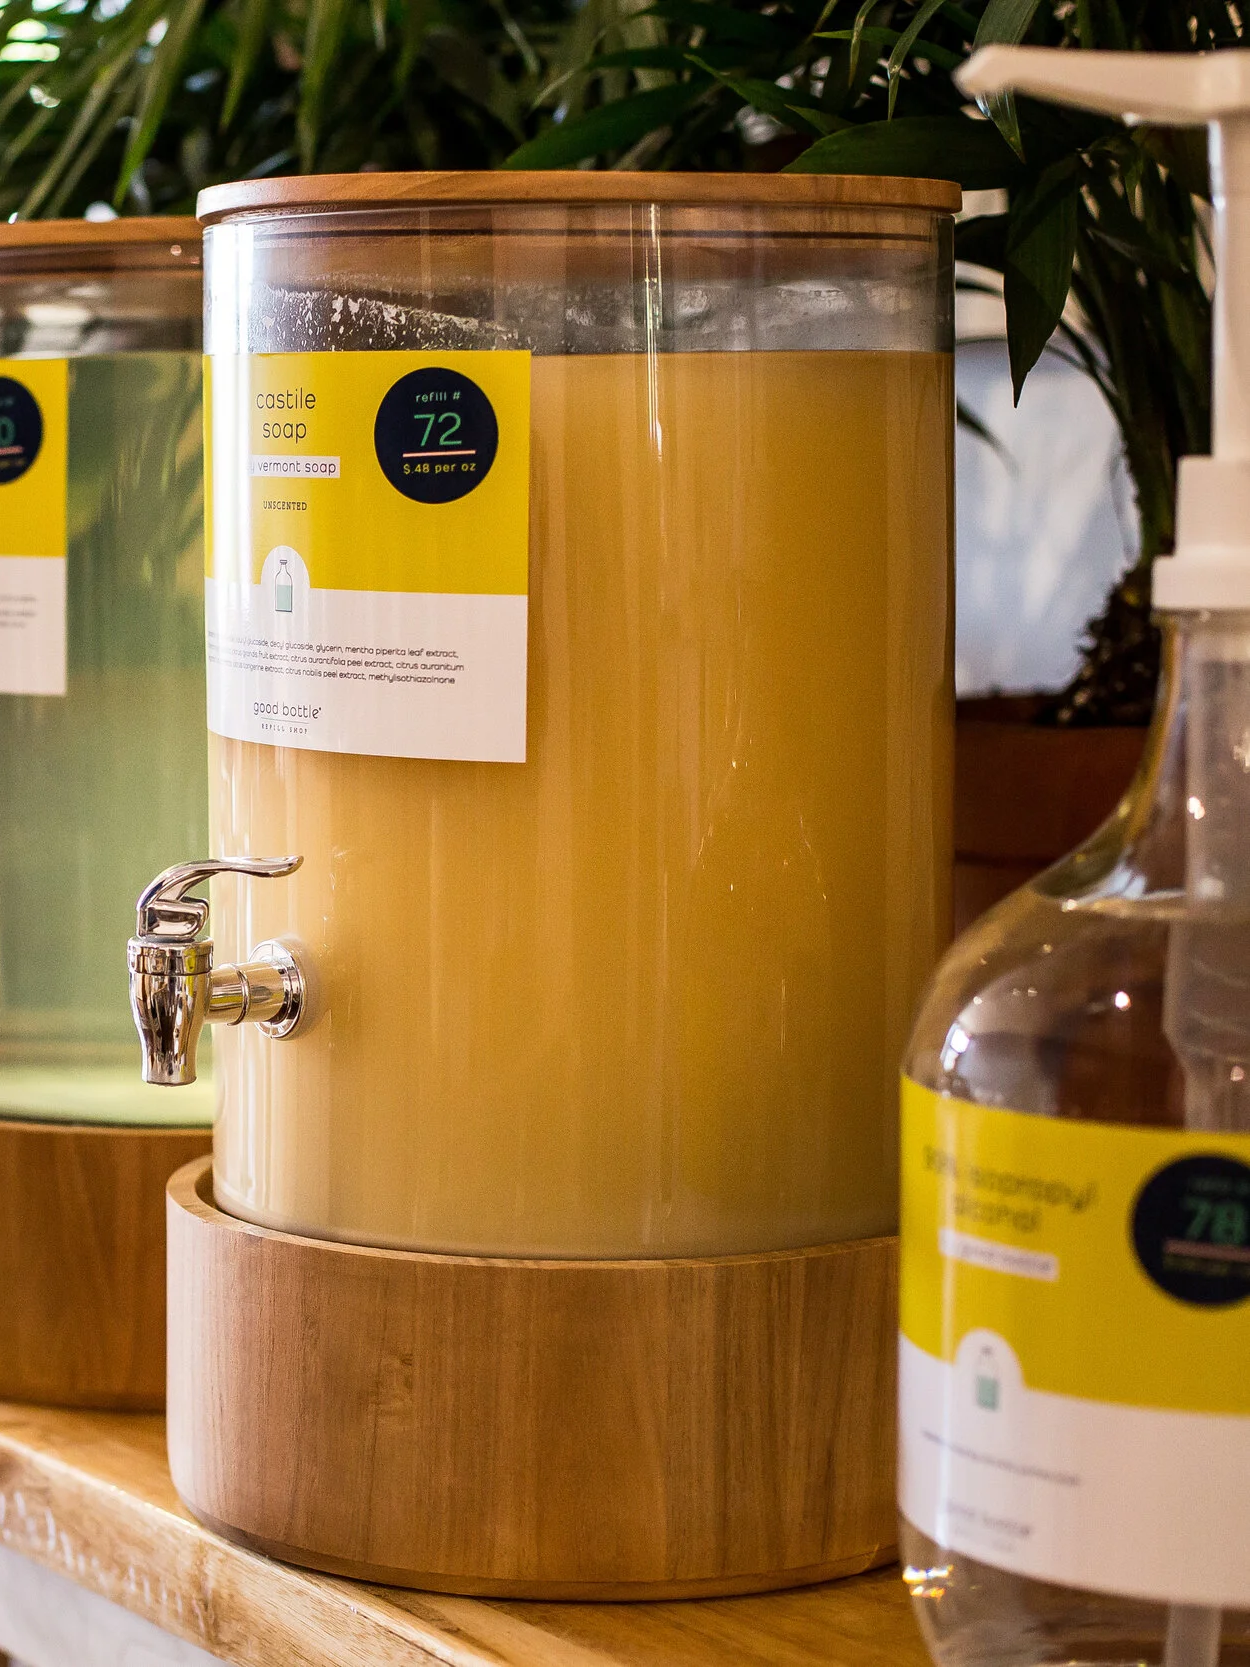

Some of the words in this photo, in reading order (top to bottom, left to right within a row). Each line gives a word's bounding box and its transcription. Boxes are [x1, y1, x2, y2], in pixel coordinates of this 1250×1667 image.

[255, 387, 316, 410] castile
[415, 392, 447, 403] refill
[453, 391, 461, 401] #
[262, 422, 307, 444] soap
[413, 412, 462, 447] 72
[257, 460, 301, 473] vermont
[304, 462, 337, 476] soap
[403, 463, 430, 475] $.48
[435, 464, 457, 474] per
[461, 463, 477, 472] oz
[263, 501, 308, 511] UNSCENTED
[345, 645, 374, 655] mentha
[407, 647, 424, 657] leaf
[253, 701, 279, 716] good
